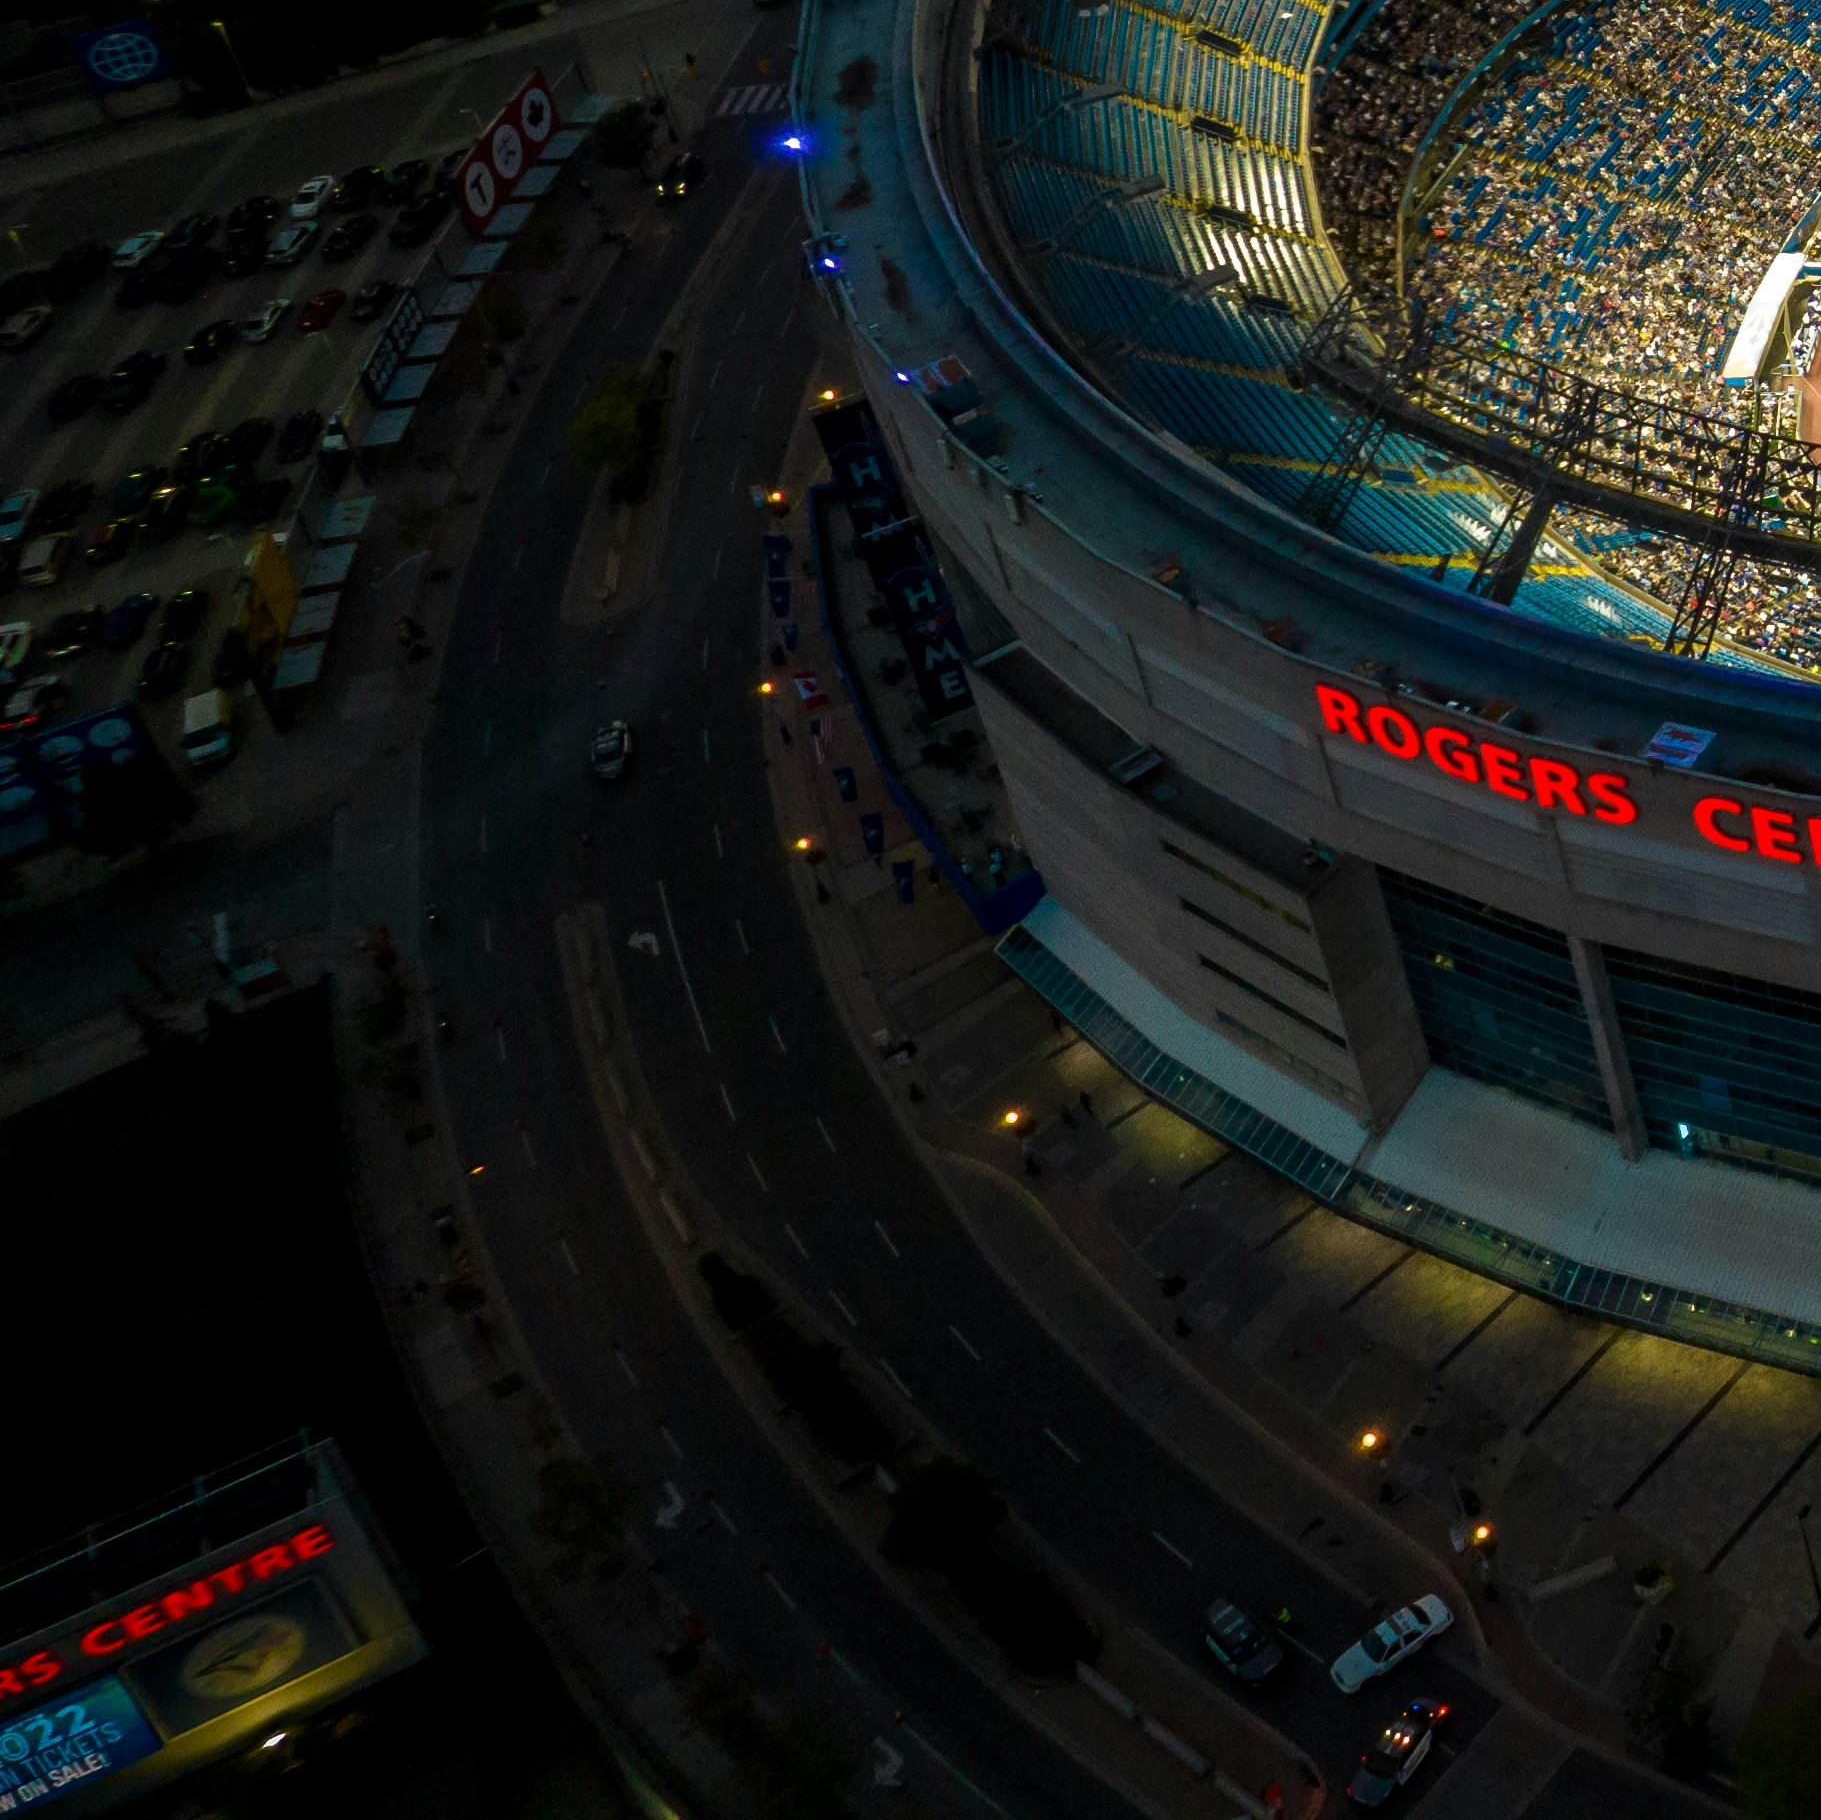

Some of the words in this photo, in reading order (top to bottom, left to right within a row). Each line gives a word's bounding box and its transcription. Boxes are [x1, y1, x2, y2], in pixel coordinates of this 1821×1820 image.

[1315, 682, 1640, 826] ROGERS
[81, 1522, 336, 1657] CENTRE
[0, 1702, 95, 1769] 022
[20, 1721, 124, 1779] TICKETS
[17, 1777, 50, 1803] ON
